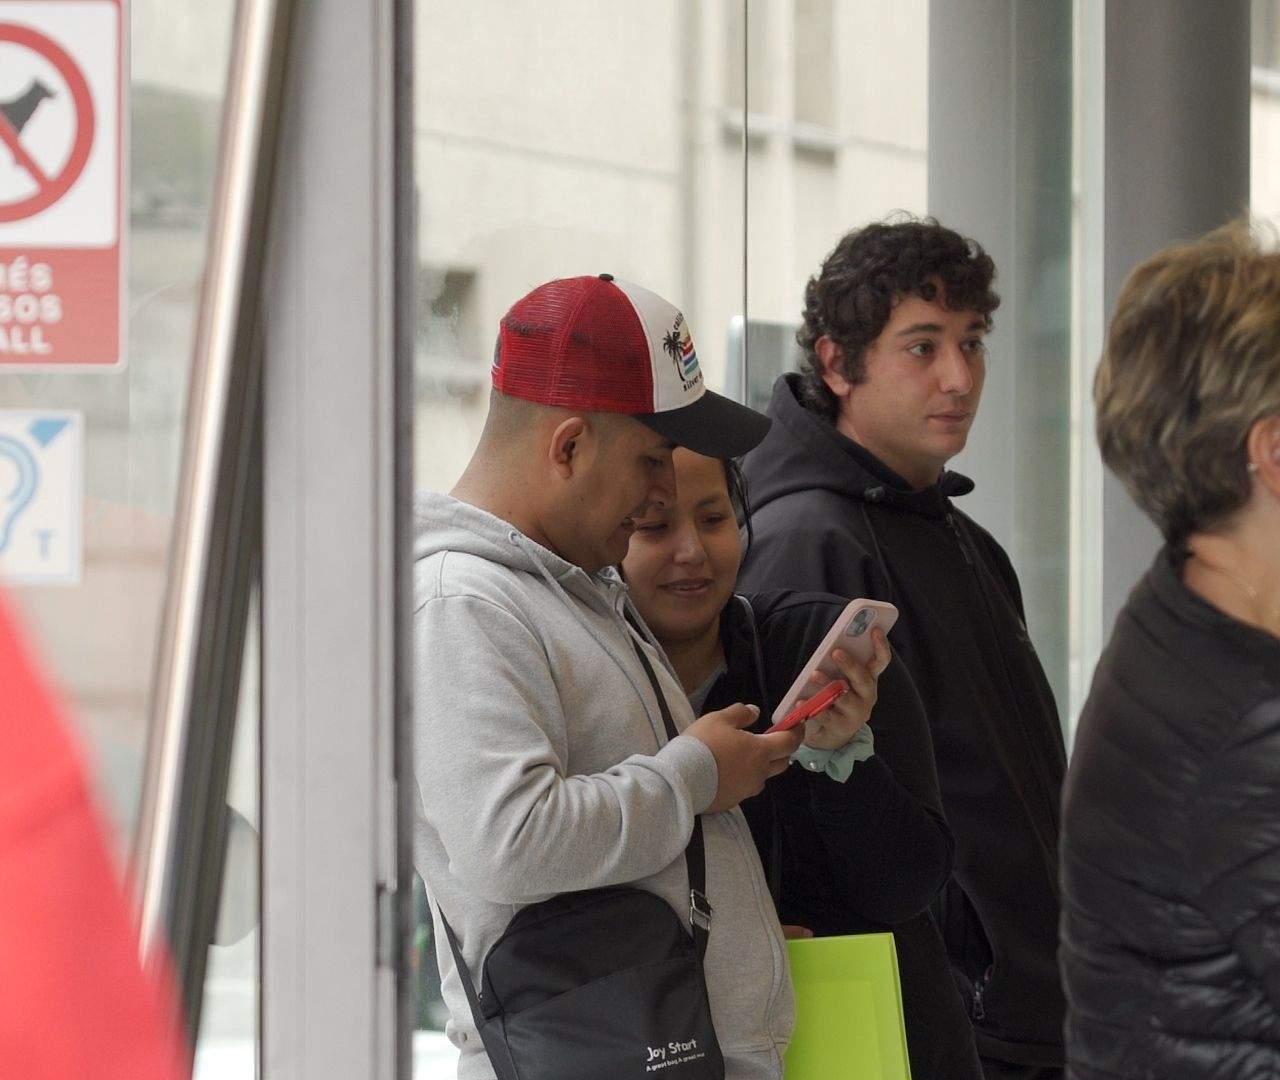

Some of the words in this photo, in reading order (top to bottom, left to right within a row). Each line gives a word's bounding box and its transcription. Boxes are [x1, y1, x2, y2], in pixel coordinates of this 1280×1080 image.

[33, 530, 54, 558] T
[647, 1047, 665, 1061] Joy
[669, 1039, 696, 1053] Start
